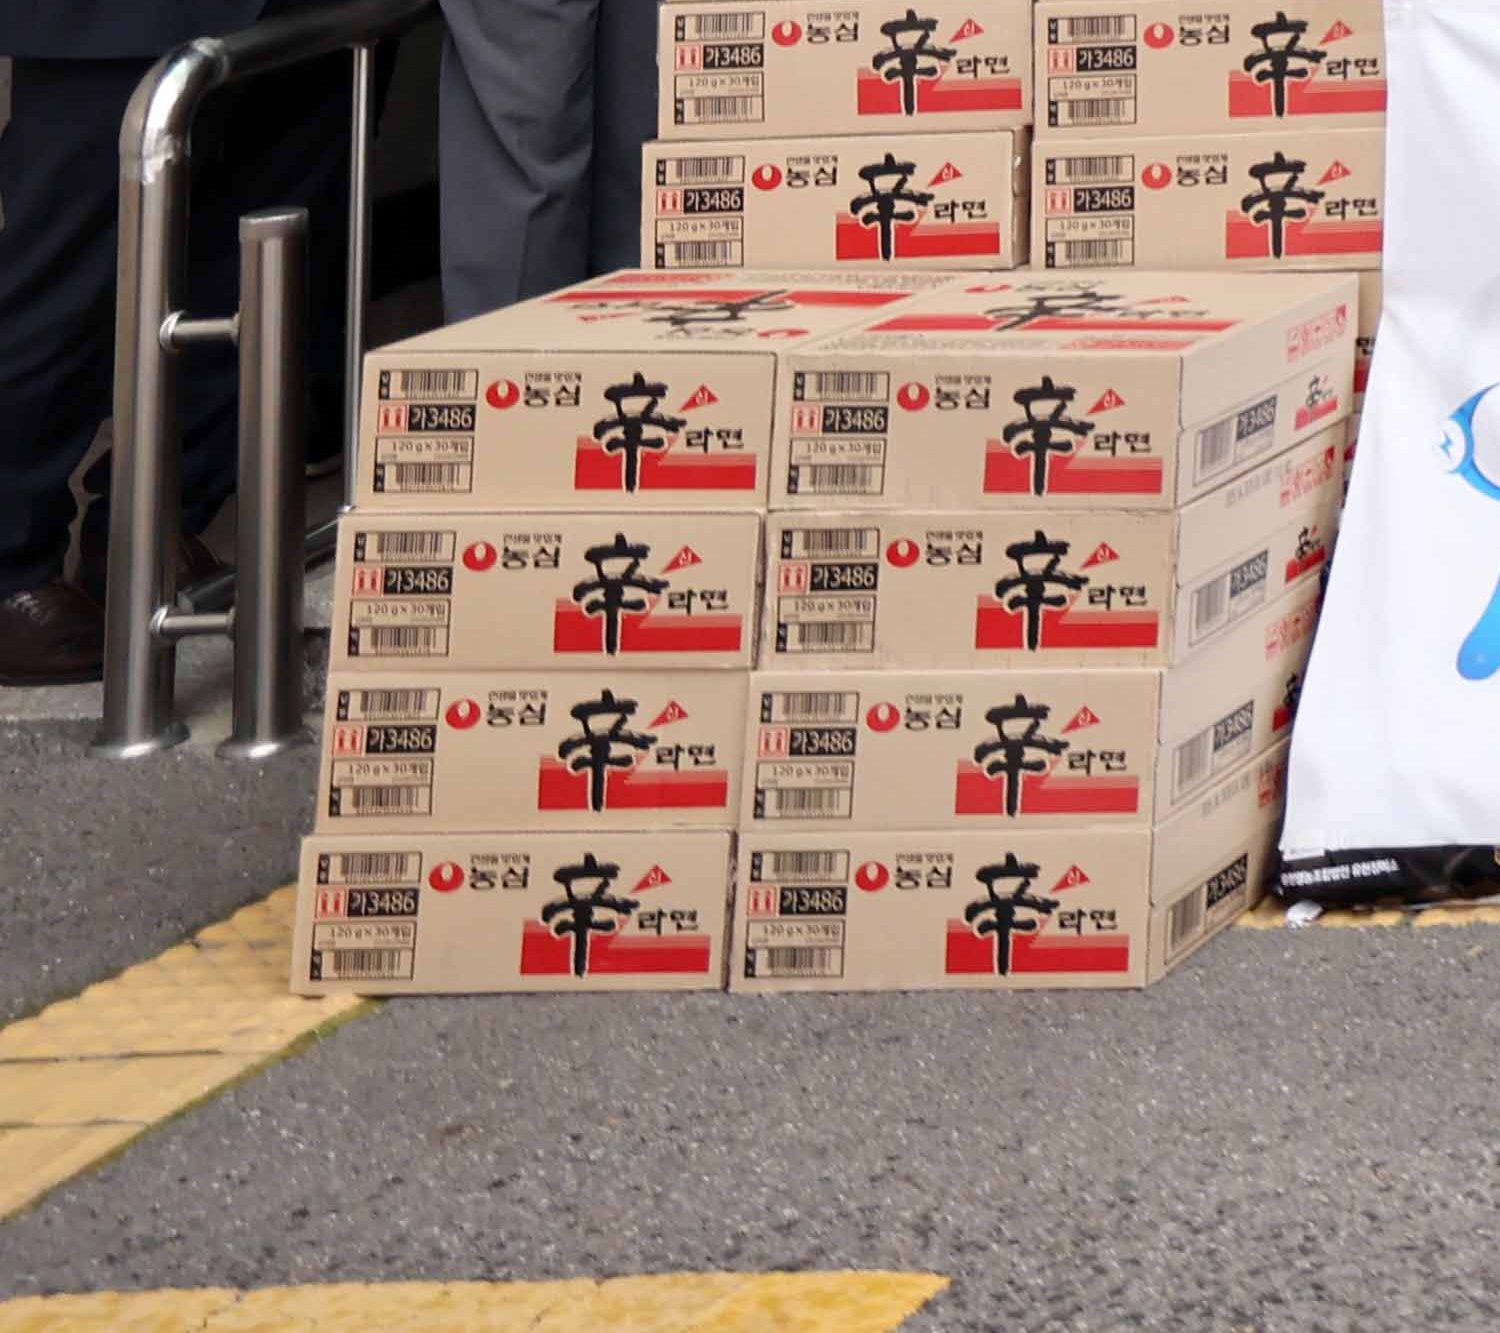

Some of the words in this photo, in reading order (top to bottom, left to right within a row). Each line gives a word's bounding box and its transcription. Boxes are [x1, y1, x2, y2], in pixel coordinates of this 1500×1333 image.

[784, 166, 837, 189] 농심
[686, 188, 740, 211] 가3486
[849, 154, 937, 261] 辛
[933, 198, 988, 223] 라면
[521, 384, 581, 408] 농심
[410, 406, 472, 429] 가3486
[588, 373, 692, 492] 辛
[684, 426, 747, 452] 라면
[923, 542, 982, 567] 농심
[813, 565, 874, 589] 가3486
[991, 531, 1093, 650] 辛
[1086, 583, 1148, 610] 라면
[466, 866, 529, 891] 농심
[350, 890, 414, 915] 가3486
[535, 853, 646, 977] 辛
[636, 907, 702, 935] 라면
